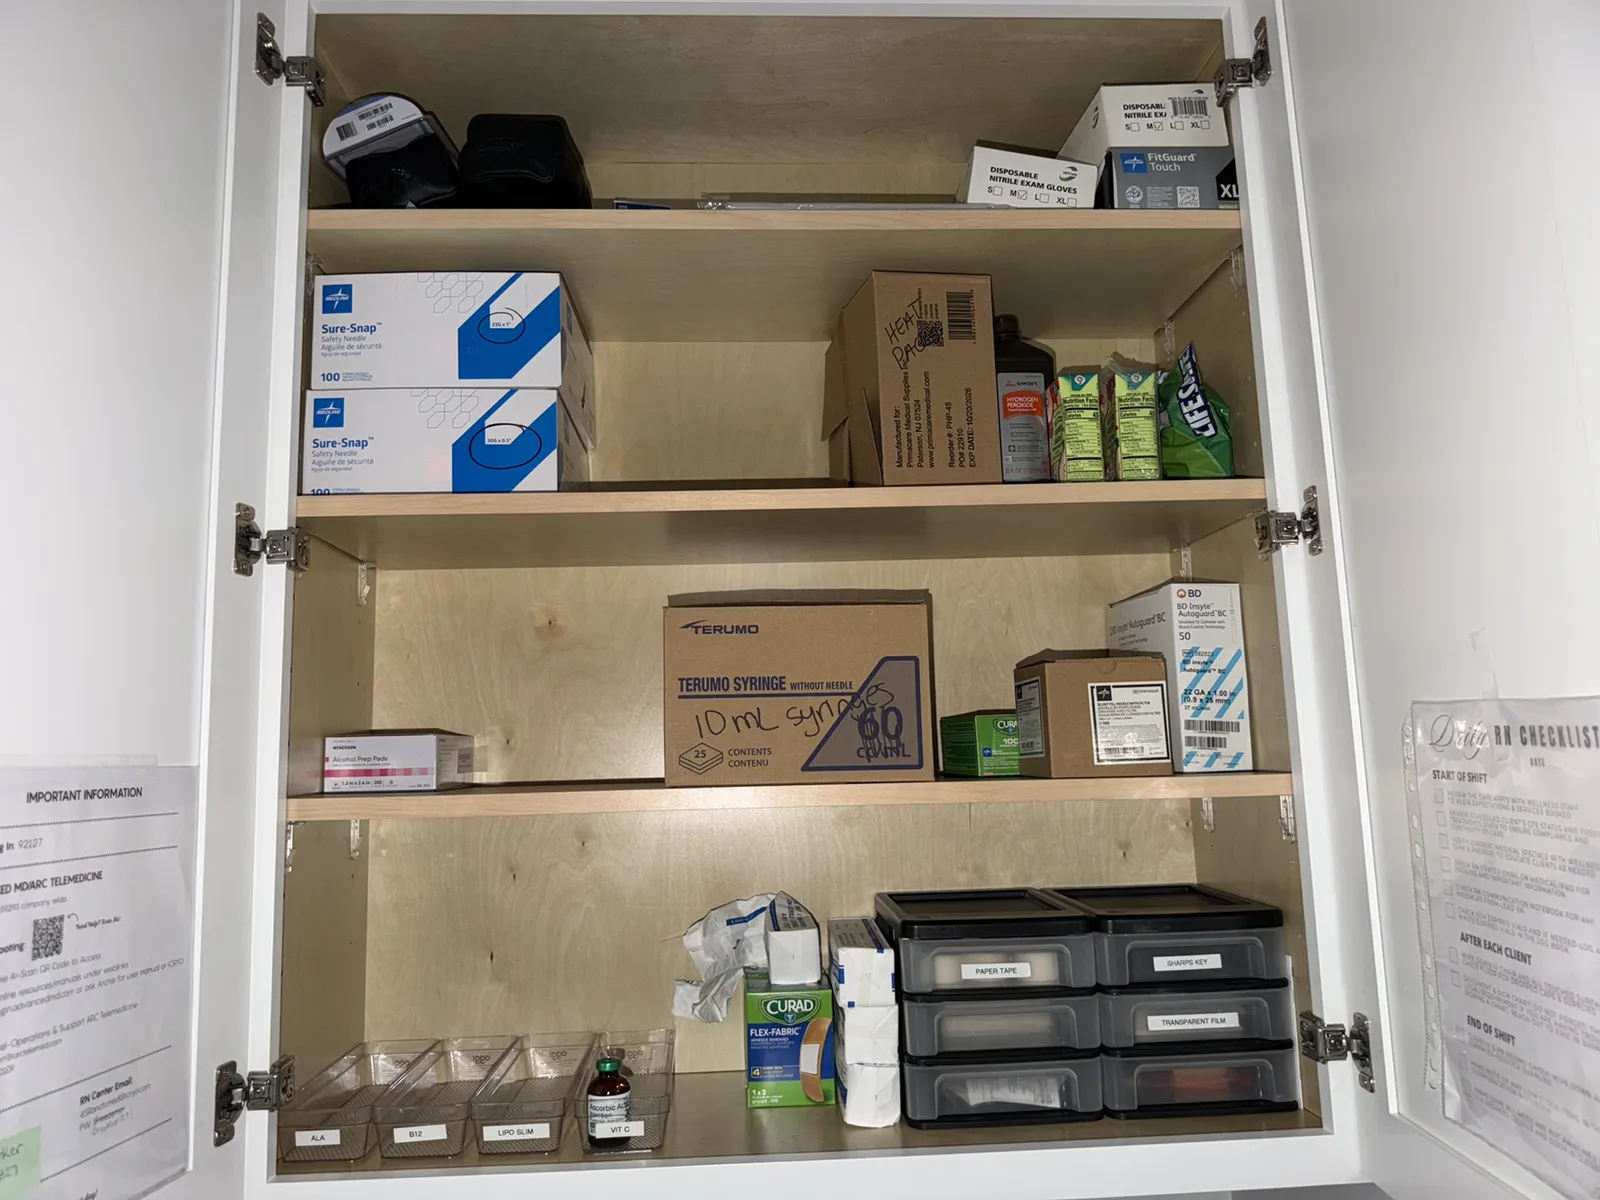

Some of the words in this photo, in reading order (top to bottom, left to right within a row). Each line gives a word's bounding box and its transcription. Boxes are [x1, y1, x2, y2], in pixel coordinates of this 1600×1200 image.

[1125, 123, 1131, 131] S
[1190, 121, 1201, 129] XL
[990, 166, 1039, 180] DISPOSABLE
[1150, 162, 1181, 172] Touch
[989, 175, 1019, 186] NITRILE
[1020, 179, 1045, 189] EXAM
[1046, 183, 1078, 195] GLOVES
[1220, 183, 1240, 198] XL
[987, 186, 993, 194] S
[1009, 189, 1017, 197] M
[1034, 193, 1040, 201] L
[1056, 196, 1067, 205] XL
[884, 297, 922, 345] HEAT
[321, 335, 343, 343] Safety
[343, 334, 367, 342] Needle
[320, 343, 345, 352] Aiguille
[356, 342, 383, 350] sécurité
[321, 372, 340, 382] 100
[902, 371, 911, 401] Supplies
[964, 387, 974, 426] 10/20/2026
[904, 404, 912, 431] Medical
[924, 371, 935, 469] www.primacaremedical.com
[944, 401, 953, 430] PHP-45
[915, 422, 922, 432] NJ
[894, 420, 903, 468] Manufactured
[957, 428, 965, 451] 22910
[967, 427, 975, 451] DATE:
[311, 450, 333, 458] Safety
[334, 449, 358, 457] Needle
[905, 432, 914, 468] Primacare
[916, 434, 924, 468] Paterson,
[947, 438, 955, 468] Reorder
[311, 458, 336, 467] Aiguille
[346, 457, 374, 465] sécurité
[958, 451, 966, 468] PO#
[1188, 589, 1202, 598] BD
[1176, 602, 1188, 610] BD
[691, 623, 759, 635] TERUMO
[1179, 631, 1191, 641] 50
[678, 677, 730, 692] TERUMO
[733, 676, 787, 692] SYRINGE
[790, 682, 825, 691] WITHOUT
[826, 681, 853, 690] NEEDLE
[1183, 696, 1198, 704] (0.9
[695, 710, 726, 738] 10
[732, 707, 779, 734] mL
[857, 706, 904, 741] 60
[1494, 725, 1512, 746] RN
[1519, 725, 1600, 749] CHECKLIST
[694, 750, 707, 759] 25
[728, 747, 772, 757] CONTENTS
[357, 756, 372, 764] Prep
[728, 759, 769, 768] CONTENU
[1432, 769, 1455, 781] START
[1456, 771, 1466, 782] OF
[1467, 772, 1488, 784] SHIFT
[26, 789, 82, 803] IMPORTANT
[83, 786, 143, 800] INFORMATION
[18, 838, 44, 849] 92127
[14, 878, 48, 893] MD/ARC
[50, 870, 103, 888] TELEMEDICINE
[1529, 902, 1565, 918] NOTEBOOK
[1565, 911, 1580, 921] FOR
[1460, 931, 1482, 949] AFTER
[1483, 939, 1503, 956] EACH
[1504, 946, 1533, 966] CLIENT
[40, 963, 51, 973] QR
[51, 959, 70, 971] Code
[80, 953, 102, 964] Access
[103, 962, 129, 974] weblinks
[1167, 958, 1192, 967] SHARPS
[1194, 957, 1208, 966] KEY
[117, 974, 126, 982] for
[126, 971, 139, 980] user
[140, 964, 160, 975] manual
[975, 967, 998, 976] PAPER
[1000, 966, 1018, 975] TAPE
[766, 999, 814, 1015] CURAD
[60, 1018, 86, 1033] Support
[86, 1012, 99, 1024] ARC
[100, 1002, 138, 1019] Telemedicine
[1161, 1017, 1209, 1027] TRANSPARENT
[1211, 1016, 1227, 1025] FILM
[1466, 1014, 1482, 1030] END
[1482, 1022, 1493, 1035] OF
[1493, 1027, 1516, 1047] SHIFT
[752, 1068, 761, 1077] 4
[80, 1093, 91, 1106] RN
[91, 1086, 114, 1100] Center
[310, 1134, 326, 1142] ALA
[408, 1130, 423, 1138] B12
[498, 1129, 515, 1137] LIPO
[516, 1128, 535, 1136] SLIM
